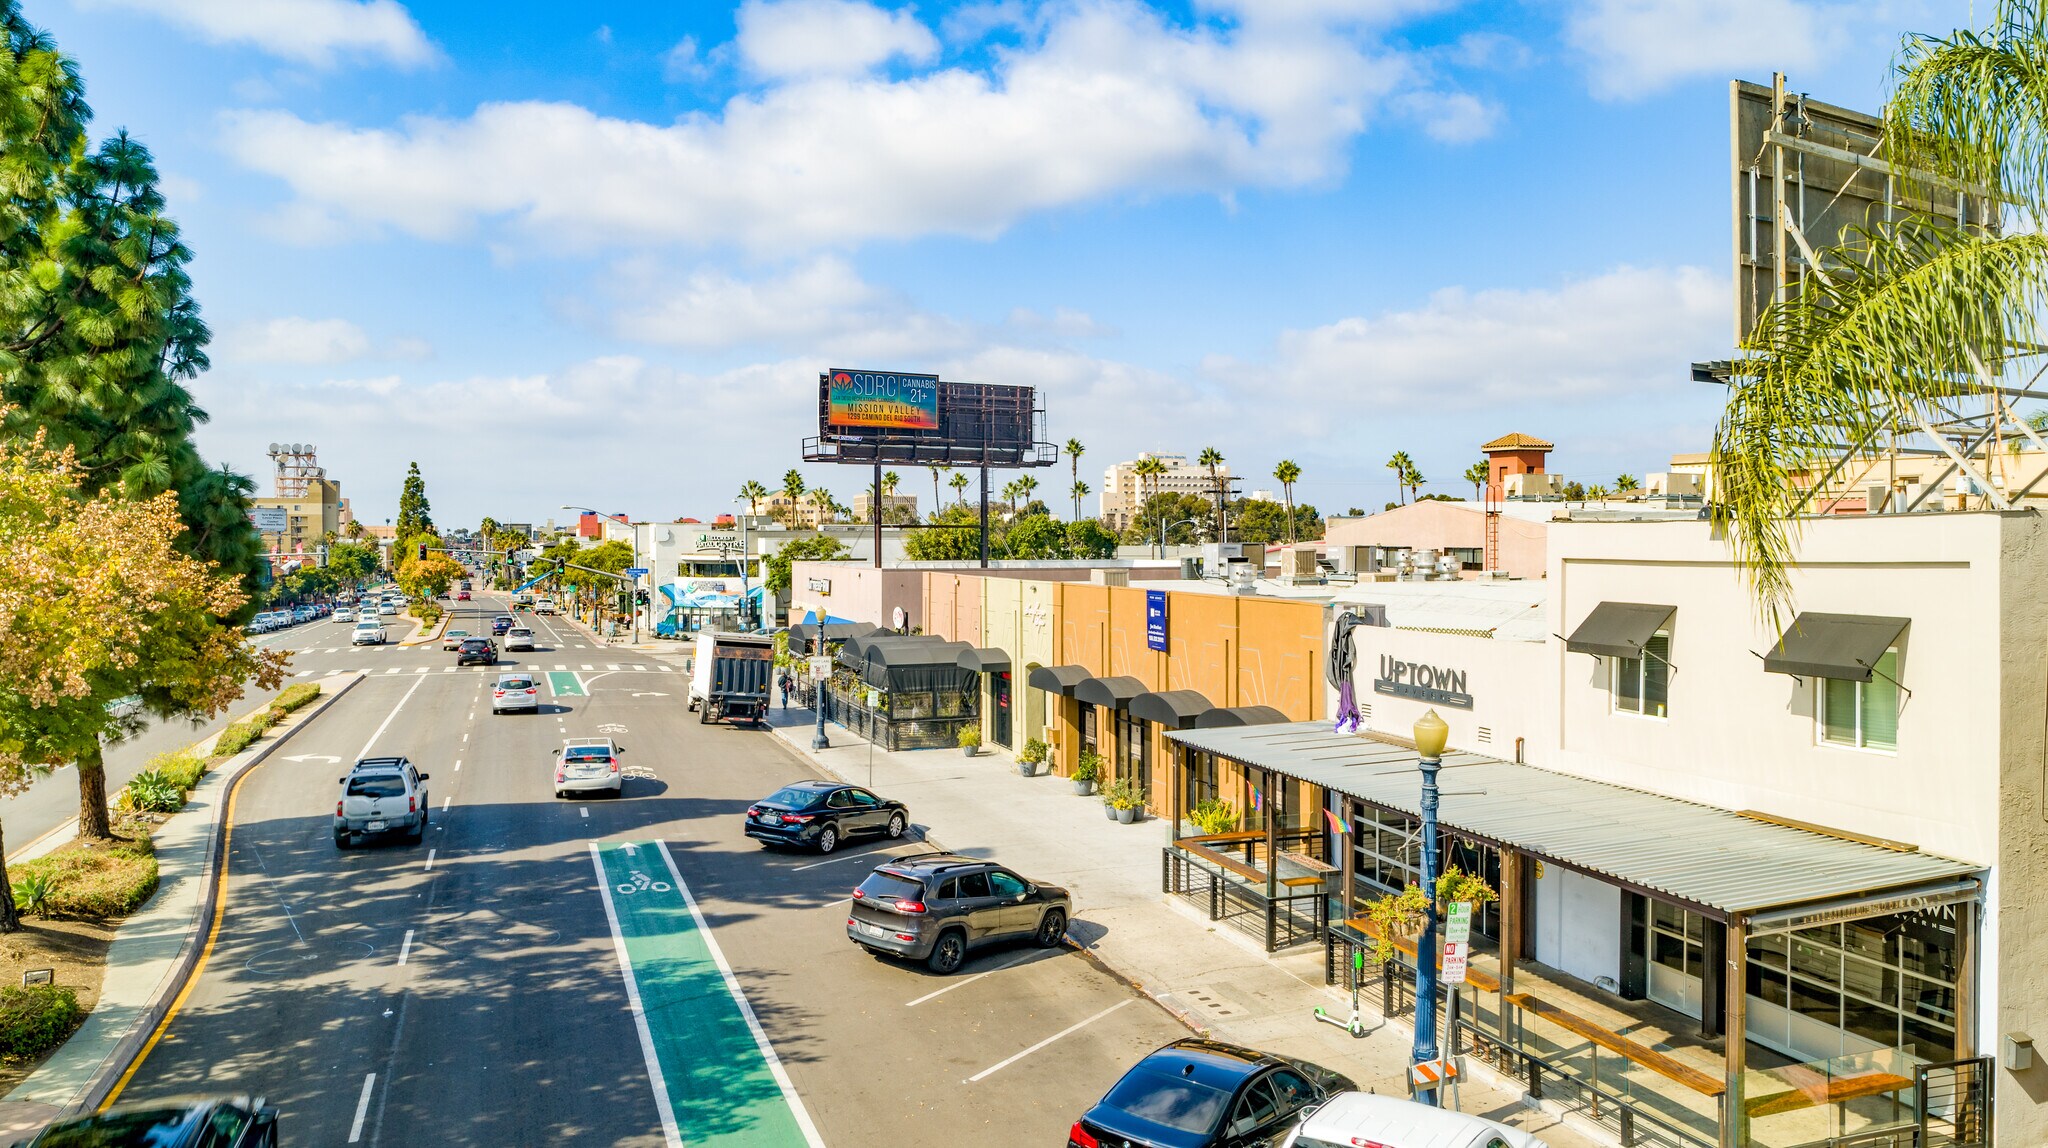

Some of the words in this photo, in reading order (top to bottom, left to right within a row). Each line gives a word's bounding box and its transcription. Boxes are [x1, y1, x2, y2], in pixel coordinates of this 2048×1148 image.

[854, 374, 896, 397] SDRC
[902, 378, 936, 389] CANNABIS
[910, 388, 928, 403] 21+
[847, 403, 884, 413] MISSION
[888, 405, 920, 415] VALLEY
[847, 412, 861, 420] 1299
[861, 413, 883, 421] CAMINO
[1380, 653, 1467, 694] UPTOWN
[1396, 685, 1446, 701] TAVERN
[1450, 904, 1456, 914] 2
[1458, 905, 1470, 913] HOUR
[1449, 916, 1468, 925] PARKING
[1893, 913, 1937, 929] AVERN
[1446, 944, 1454, 954] NO
[1445, 956, 1465, 965] PARKING
